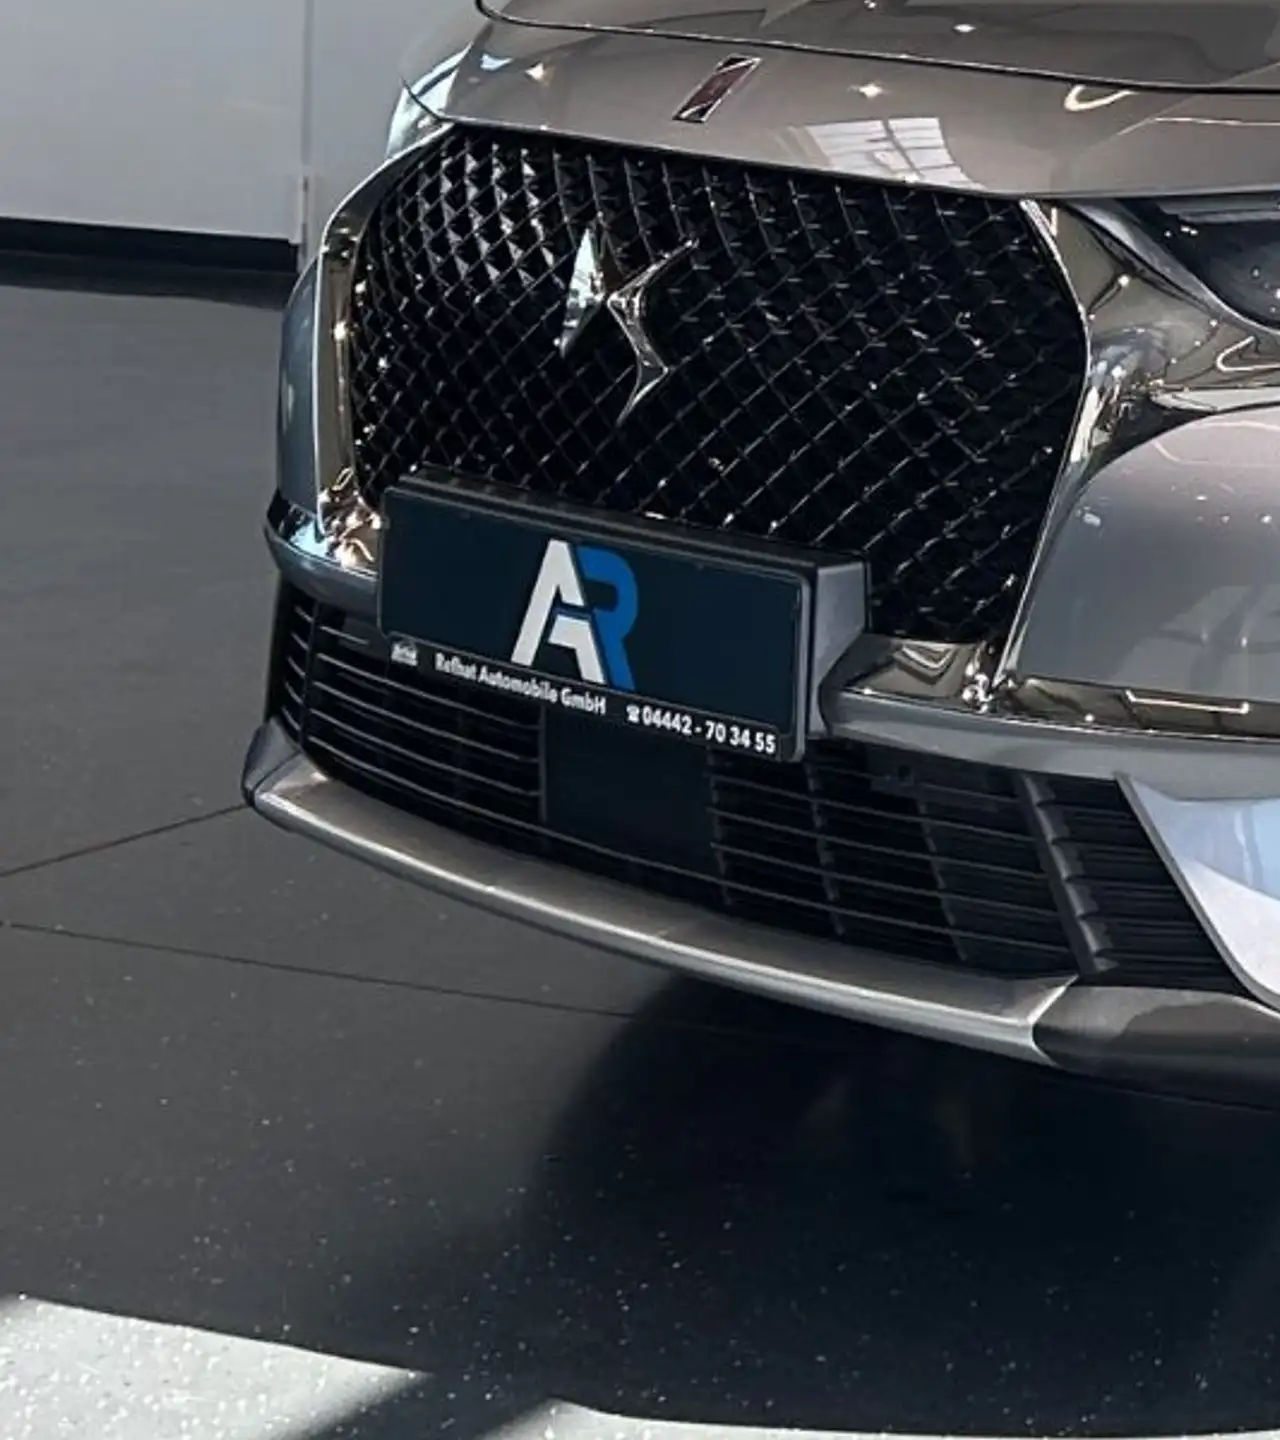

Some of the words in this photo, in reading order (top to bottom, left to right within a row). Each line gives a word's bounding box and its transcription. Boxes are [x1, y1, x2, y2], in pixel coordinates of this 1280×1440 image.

[511, 539, 638, 690] AR
[435, 652, 476, 680] Refhat
[478, 665, 558, 703] Automobile
[560, 688, 606, 716] GmbH
[642, 706, 692, 736] 04442
[705, 720, 726, 743] 70
[729, 725, 750, 748] 34
[755, 732, 776, 754] 55
